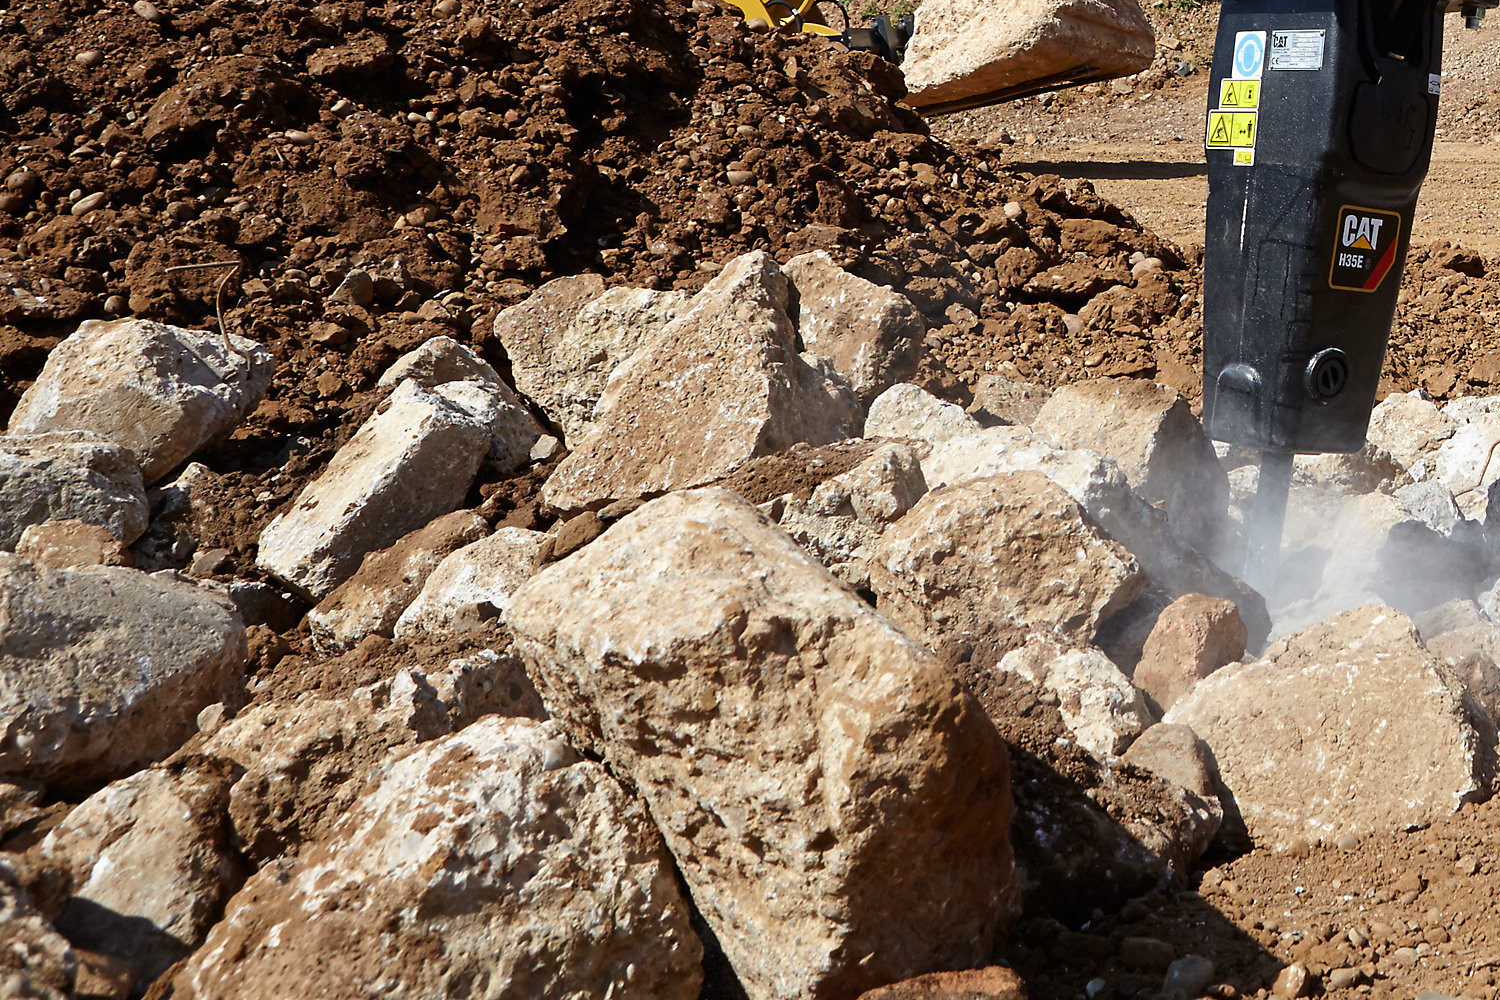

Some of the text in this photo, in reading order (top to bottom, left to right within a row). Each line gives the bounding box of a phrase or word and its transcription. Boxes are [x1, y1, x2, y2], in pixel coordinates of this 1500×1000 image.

[1273, 35, 1288, 48] CAT
[1342, 214, 1383, 250] CAT
[1338, 252, 1364, 269] H35E
